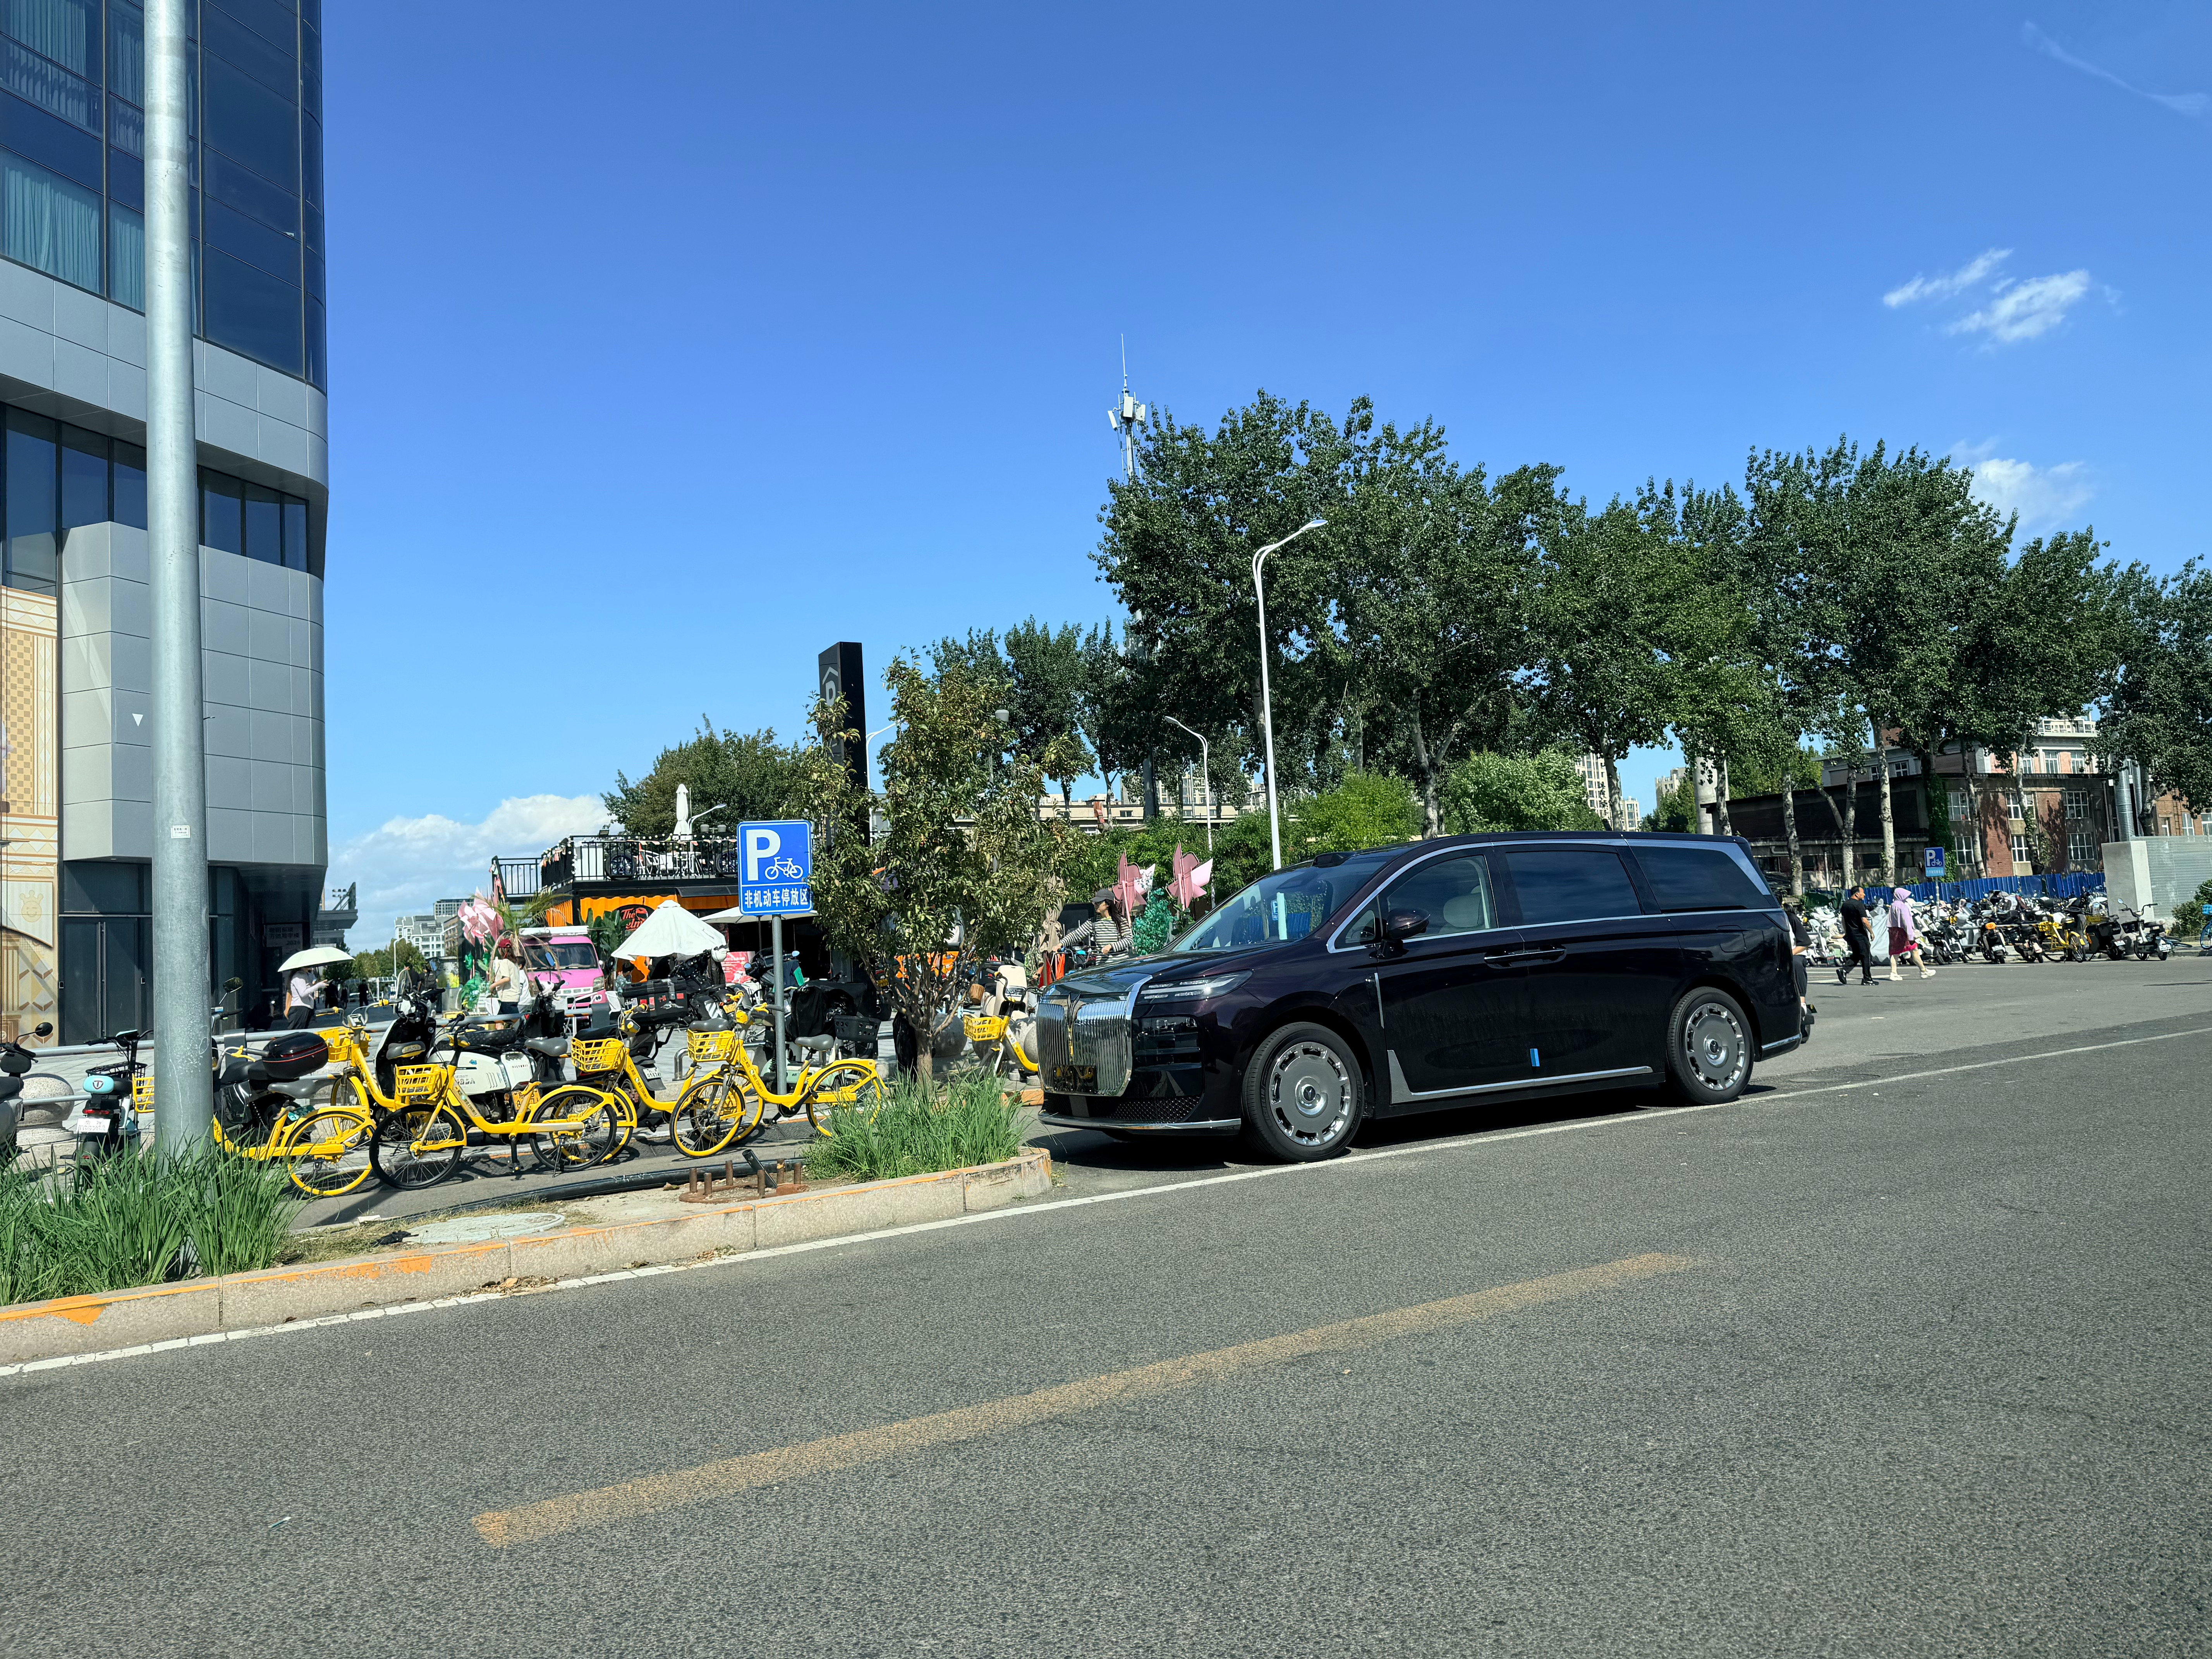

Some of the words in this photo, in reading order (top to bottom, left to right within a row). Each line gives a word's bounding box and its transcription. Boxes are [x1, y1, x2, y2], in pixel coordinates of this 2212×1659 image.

[746, 829, 781, 881] P
[1926, 850, 1936, 866] P
[744, 888, 808, 908] 非机动车停放区
[621, 908, 635, 920] The
